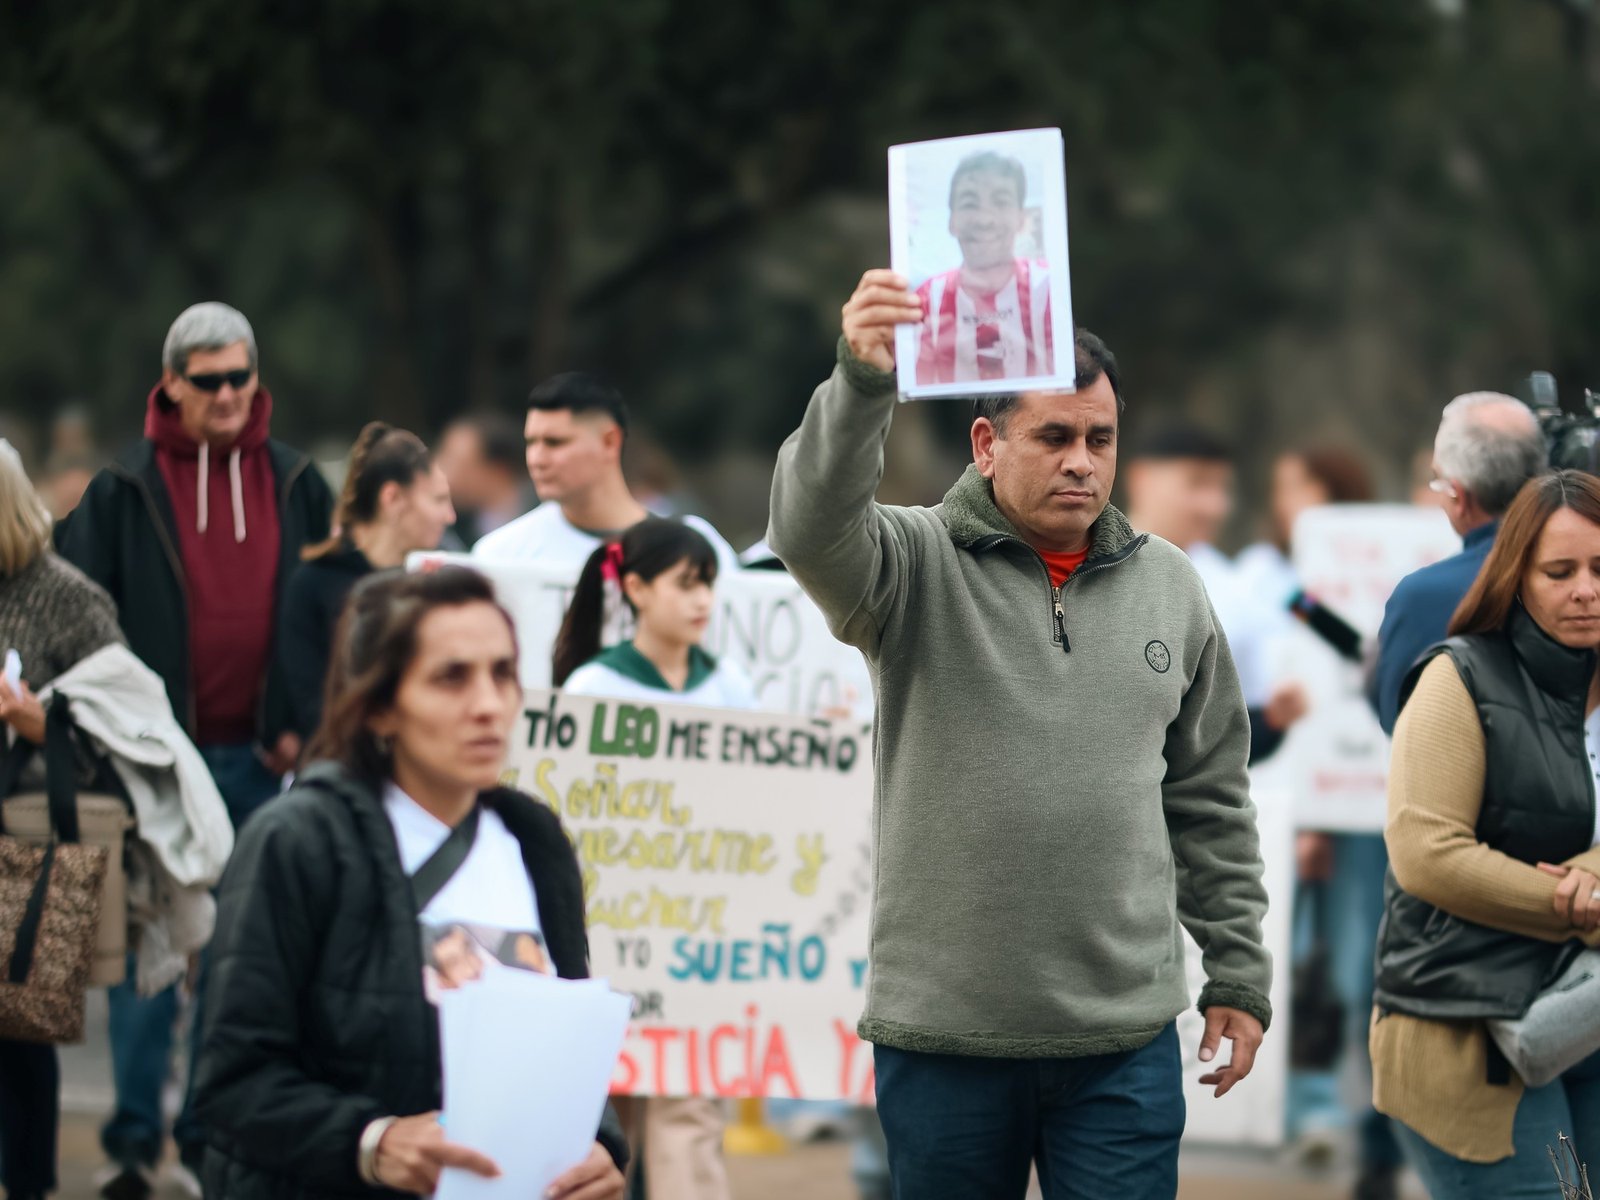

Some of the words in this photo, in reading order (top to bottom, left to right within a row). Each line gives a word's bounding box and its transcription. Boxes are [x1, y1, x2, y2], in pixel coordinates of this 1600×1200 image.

[524, 694, 577, 749] TÍO
[588, 702, 660, 758] LEO
[667, 719, 711, 760] ME
[616, 935, 651, 970] YO
[668, 923, 827, 983] SUEÑO
